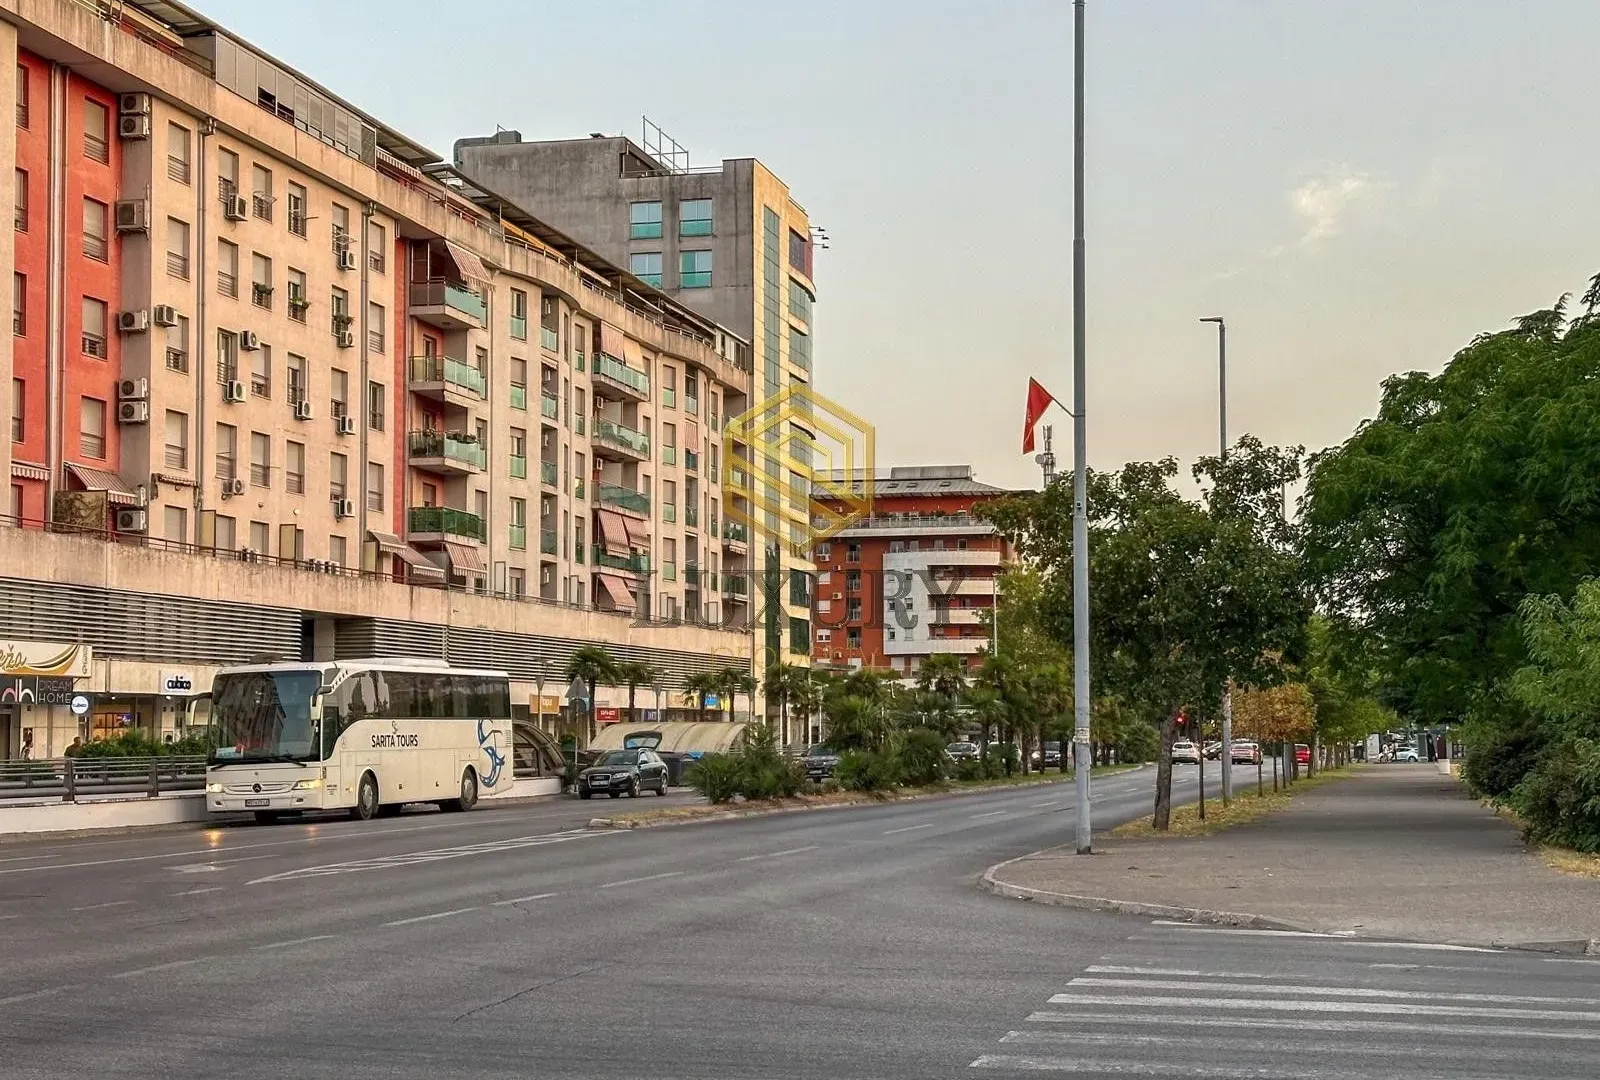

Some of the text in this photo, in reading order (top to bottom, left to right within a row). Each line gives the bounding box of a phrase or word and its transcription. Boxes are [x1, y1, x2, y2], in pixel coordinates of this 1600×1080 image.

[39, 680, 72, 692] DREAM
[39, 692, 71, 703] HOME
[371, 734, 419, 748] SARITA TOURS
